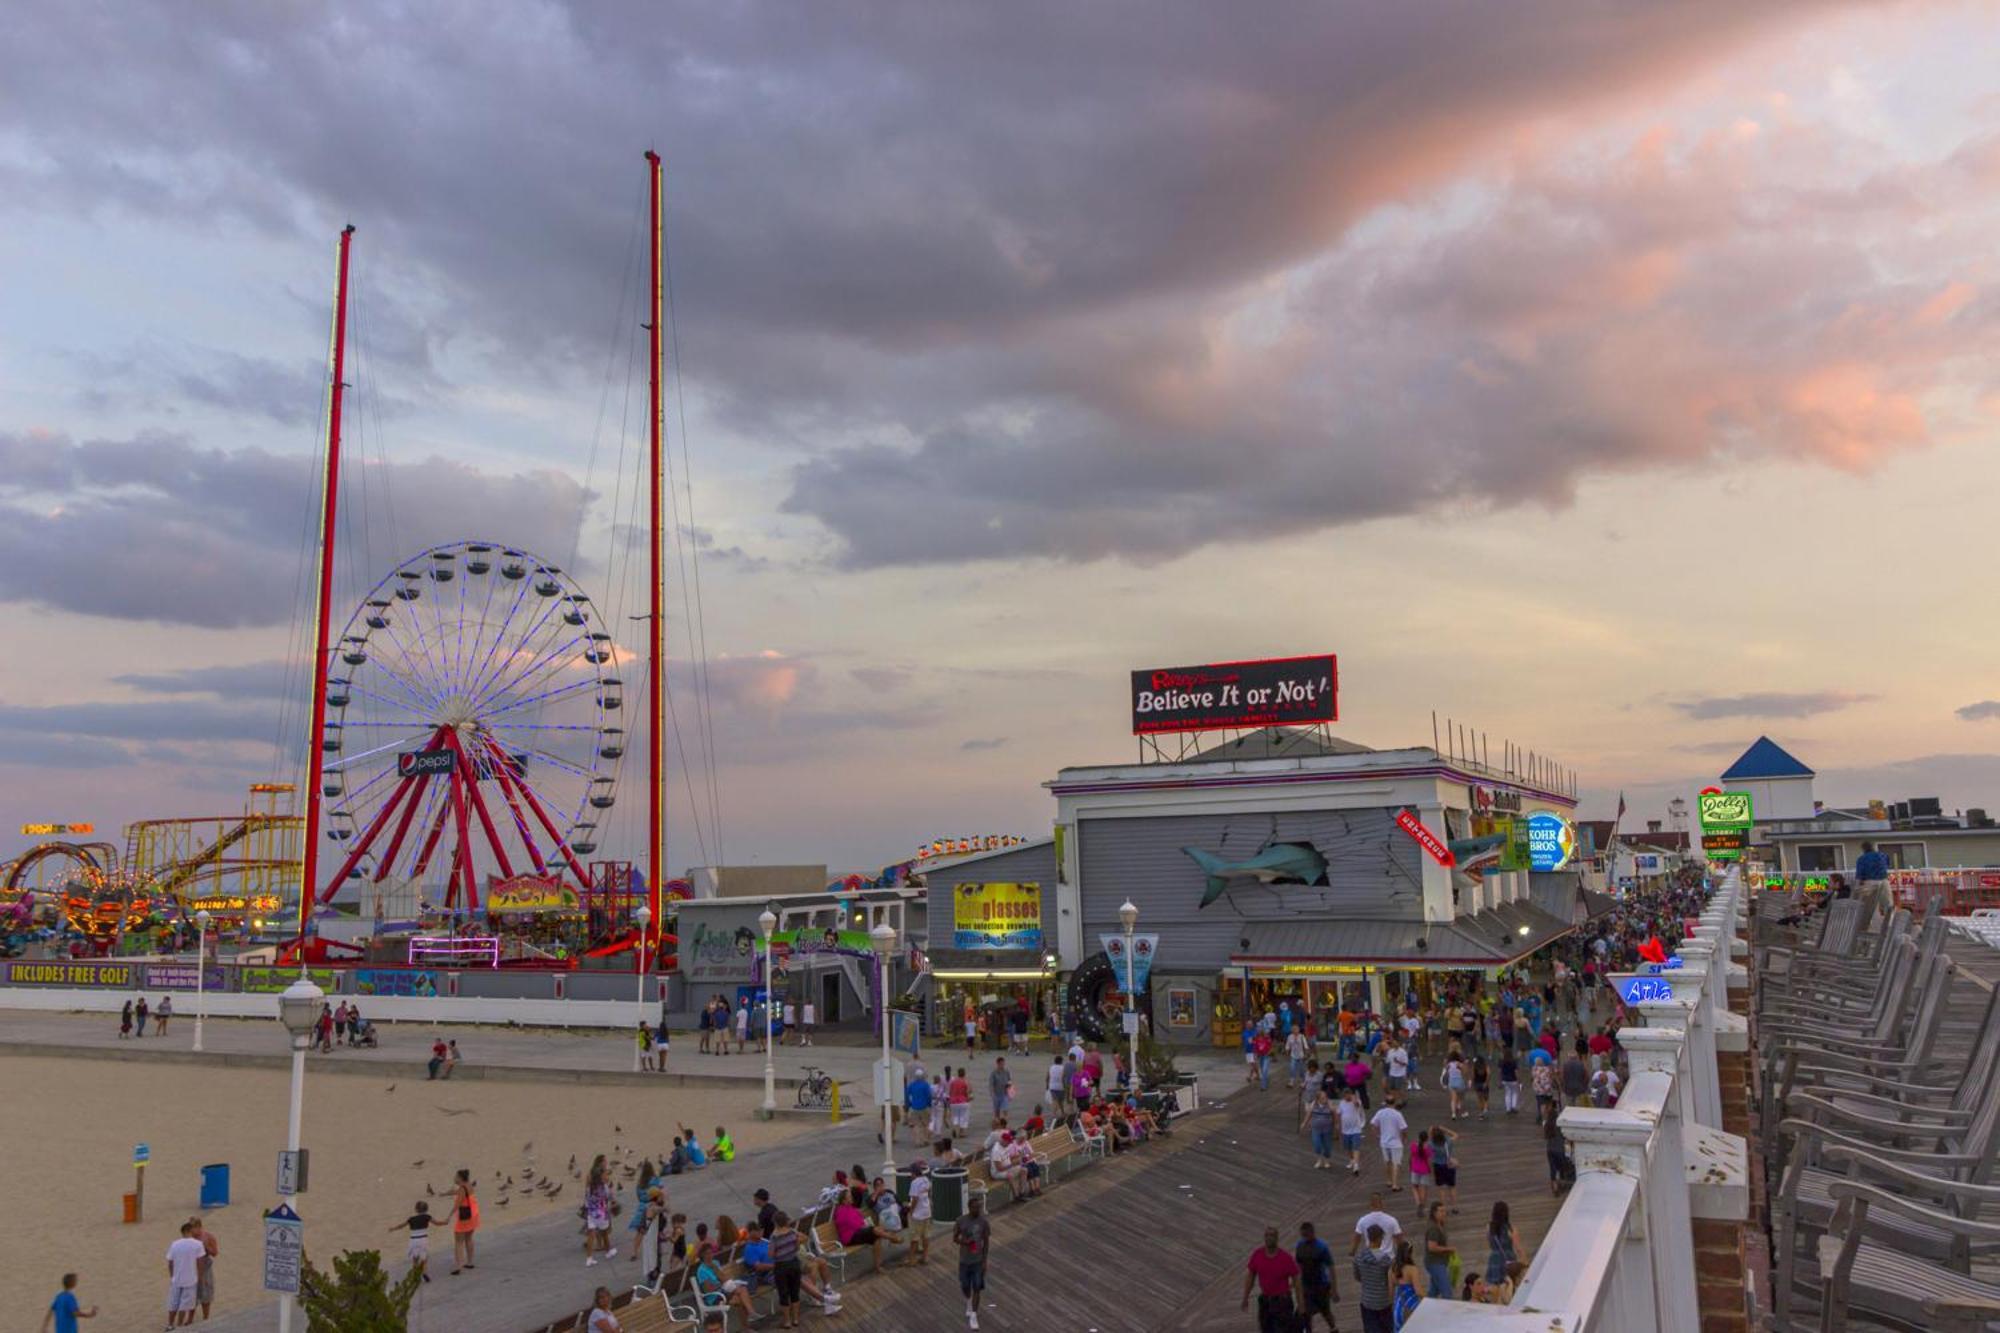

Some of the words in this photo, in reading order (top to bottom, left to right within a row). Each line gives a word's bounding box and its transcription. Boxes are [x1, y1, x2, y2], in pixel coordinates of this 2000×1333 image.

[1136, 689, 1214, 712] Believe
[1219, 684, 1239, 706] It
[1247, 688, 1272, 705] or
[418, 756, 451, 771] pepsi
[1401, 815, 1446, 858] ENTRANCE
[1529, 829, 1556, 841] KOHR
[1530, 841, 1556, 852] BROS
[11, 964, 65, 982] INCLUDES
[67, 966, 96, 984] FREE
[98, 967, 129, 985] GOLF
